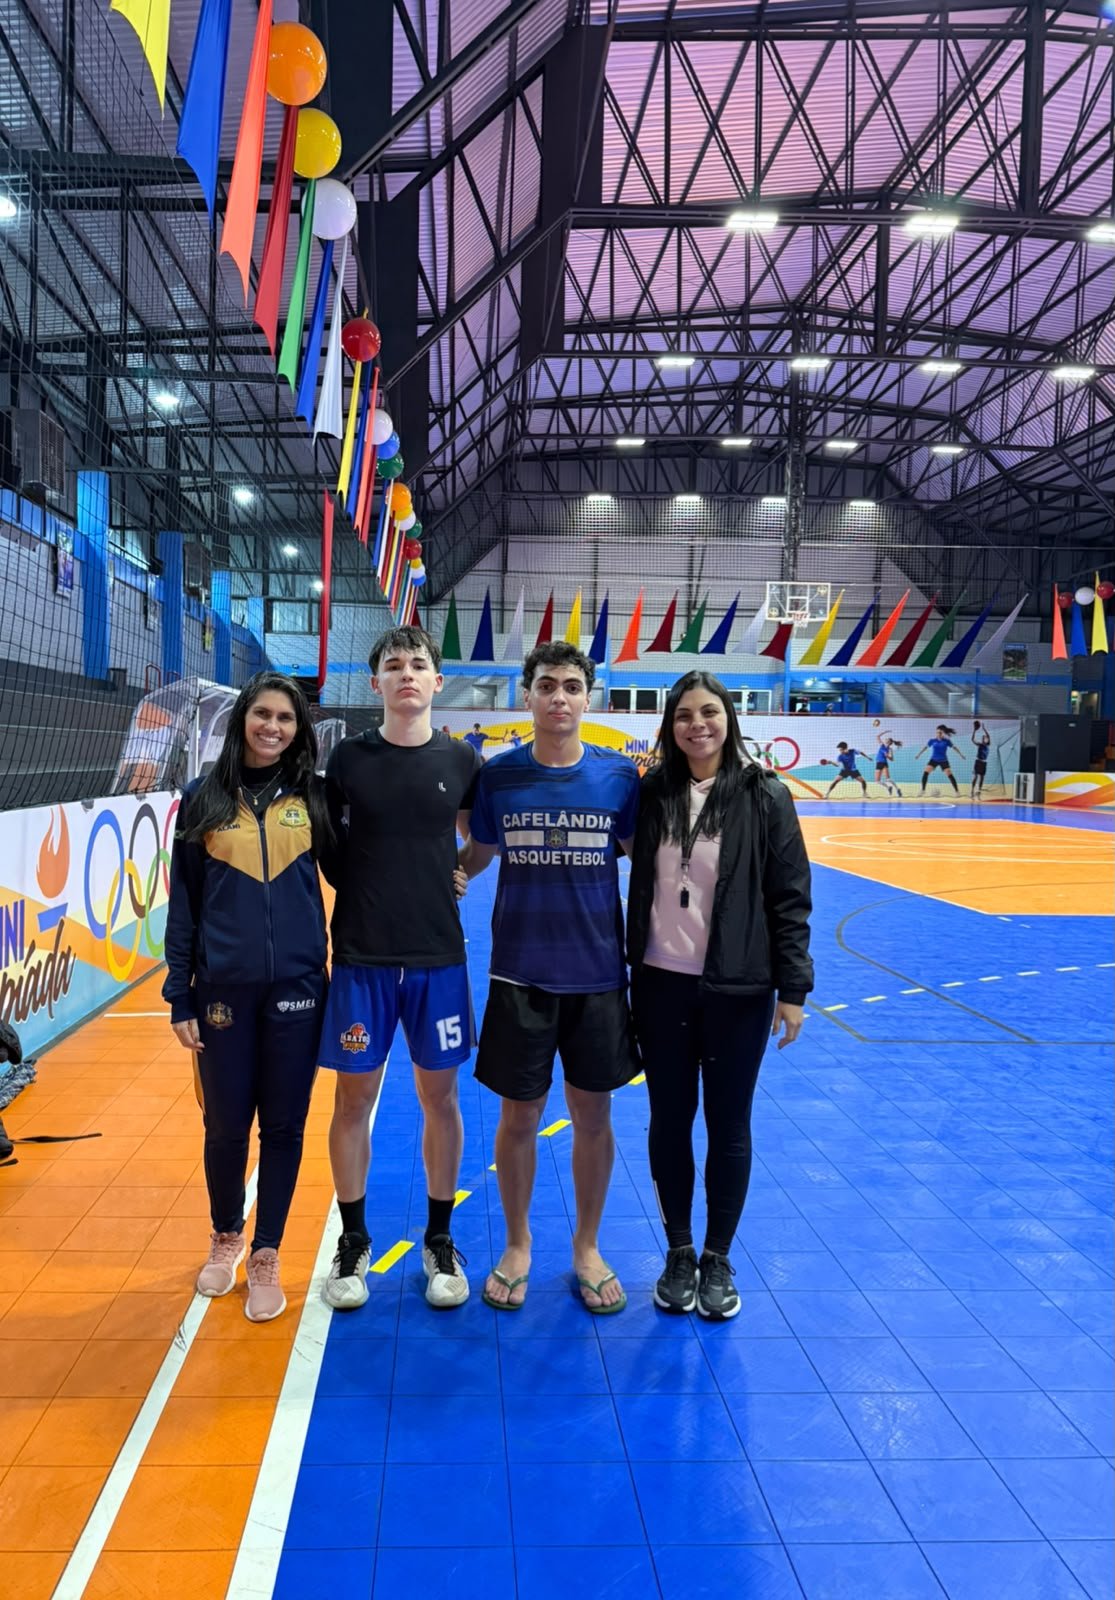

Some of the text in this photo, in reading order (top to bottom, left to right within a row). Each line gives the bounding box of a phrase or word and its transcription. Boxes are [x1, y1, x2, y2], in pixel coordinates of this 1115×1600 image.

[625, 739, 649, 753] MINI
[502, 810, 611, 830] CAFELÂNDIA
[436, 1014, 462, 1051] 15
